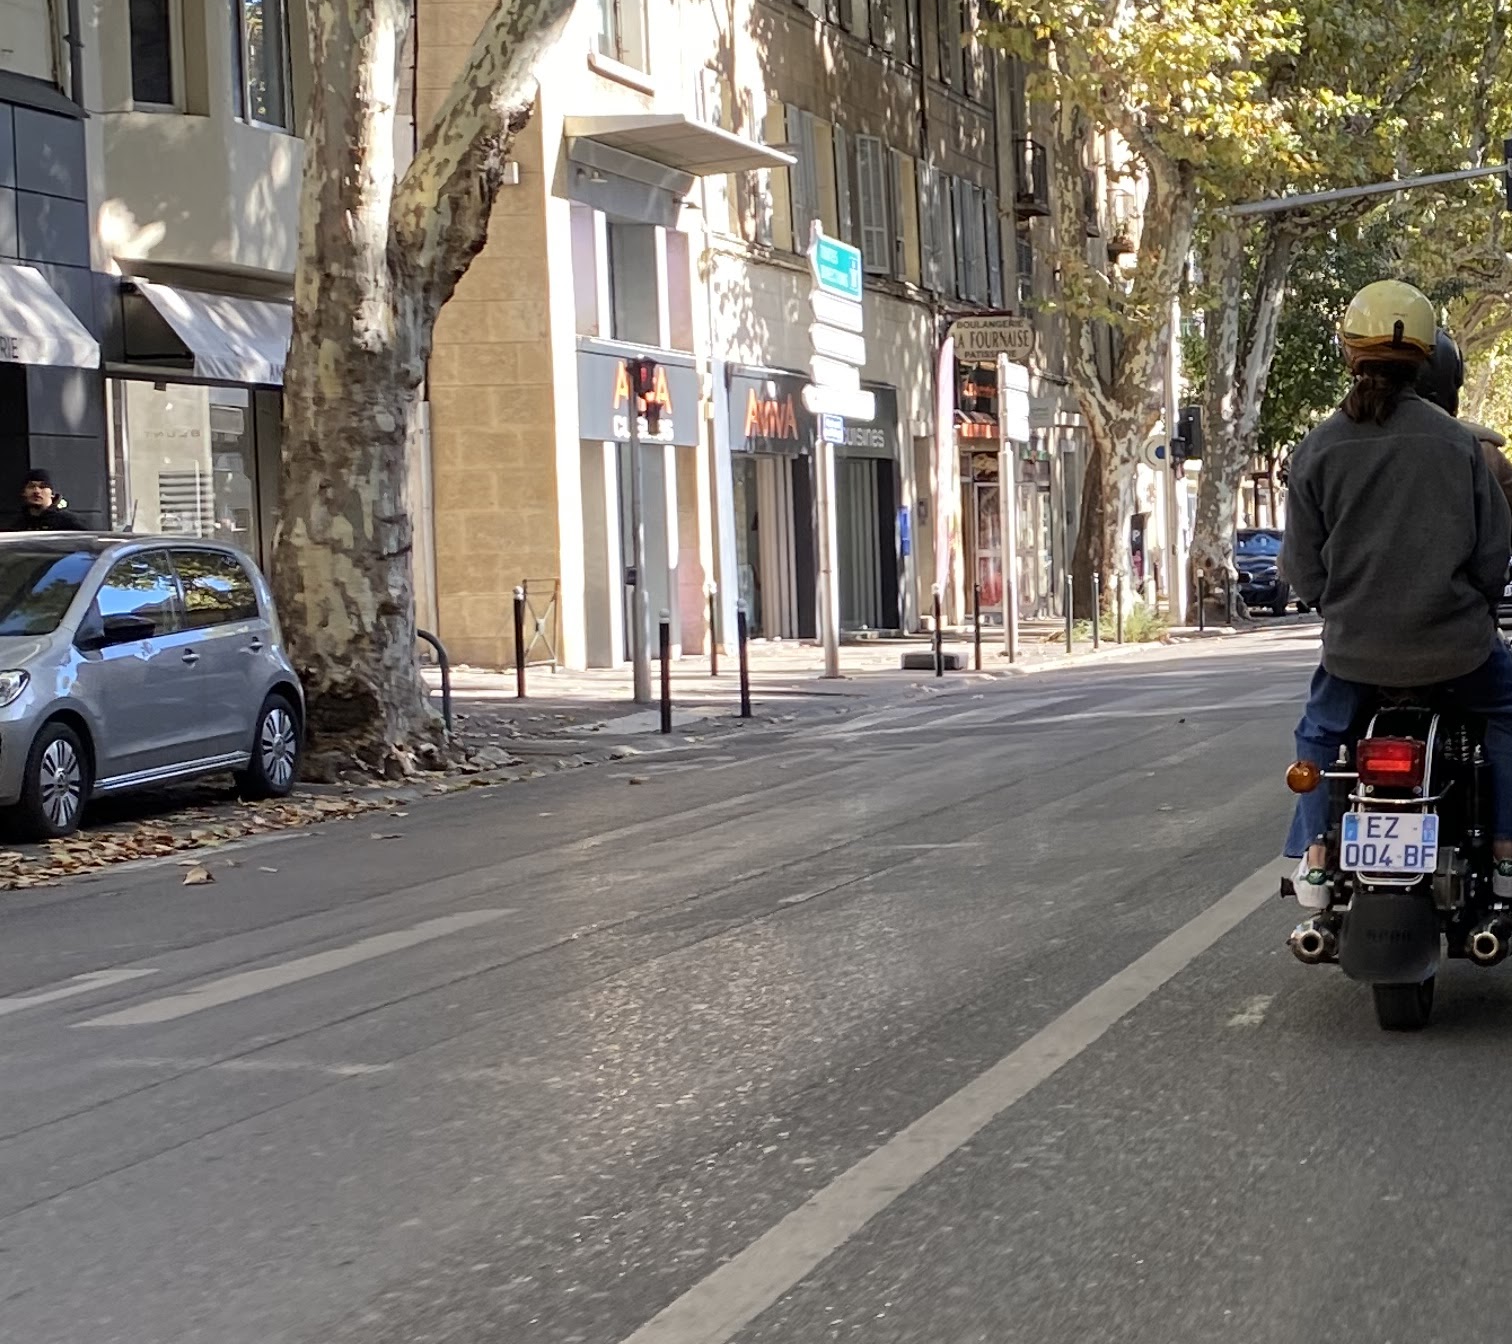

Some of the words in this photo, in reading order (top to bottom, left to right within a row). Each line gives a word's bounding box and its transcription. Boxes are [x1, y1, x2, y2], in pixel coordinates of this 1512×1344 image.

[970, 330, 1029, 349] FOURNAISE
[1367, 816, 1399, 838] EZ
[1345, 843, 1392, 866] 004
[1404, 844, 1436, 868] BF
